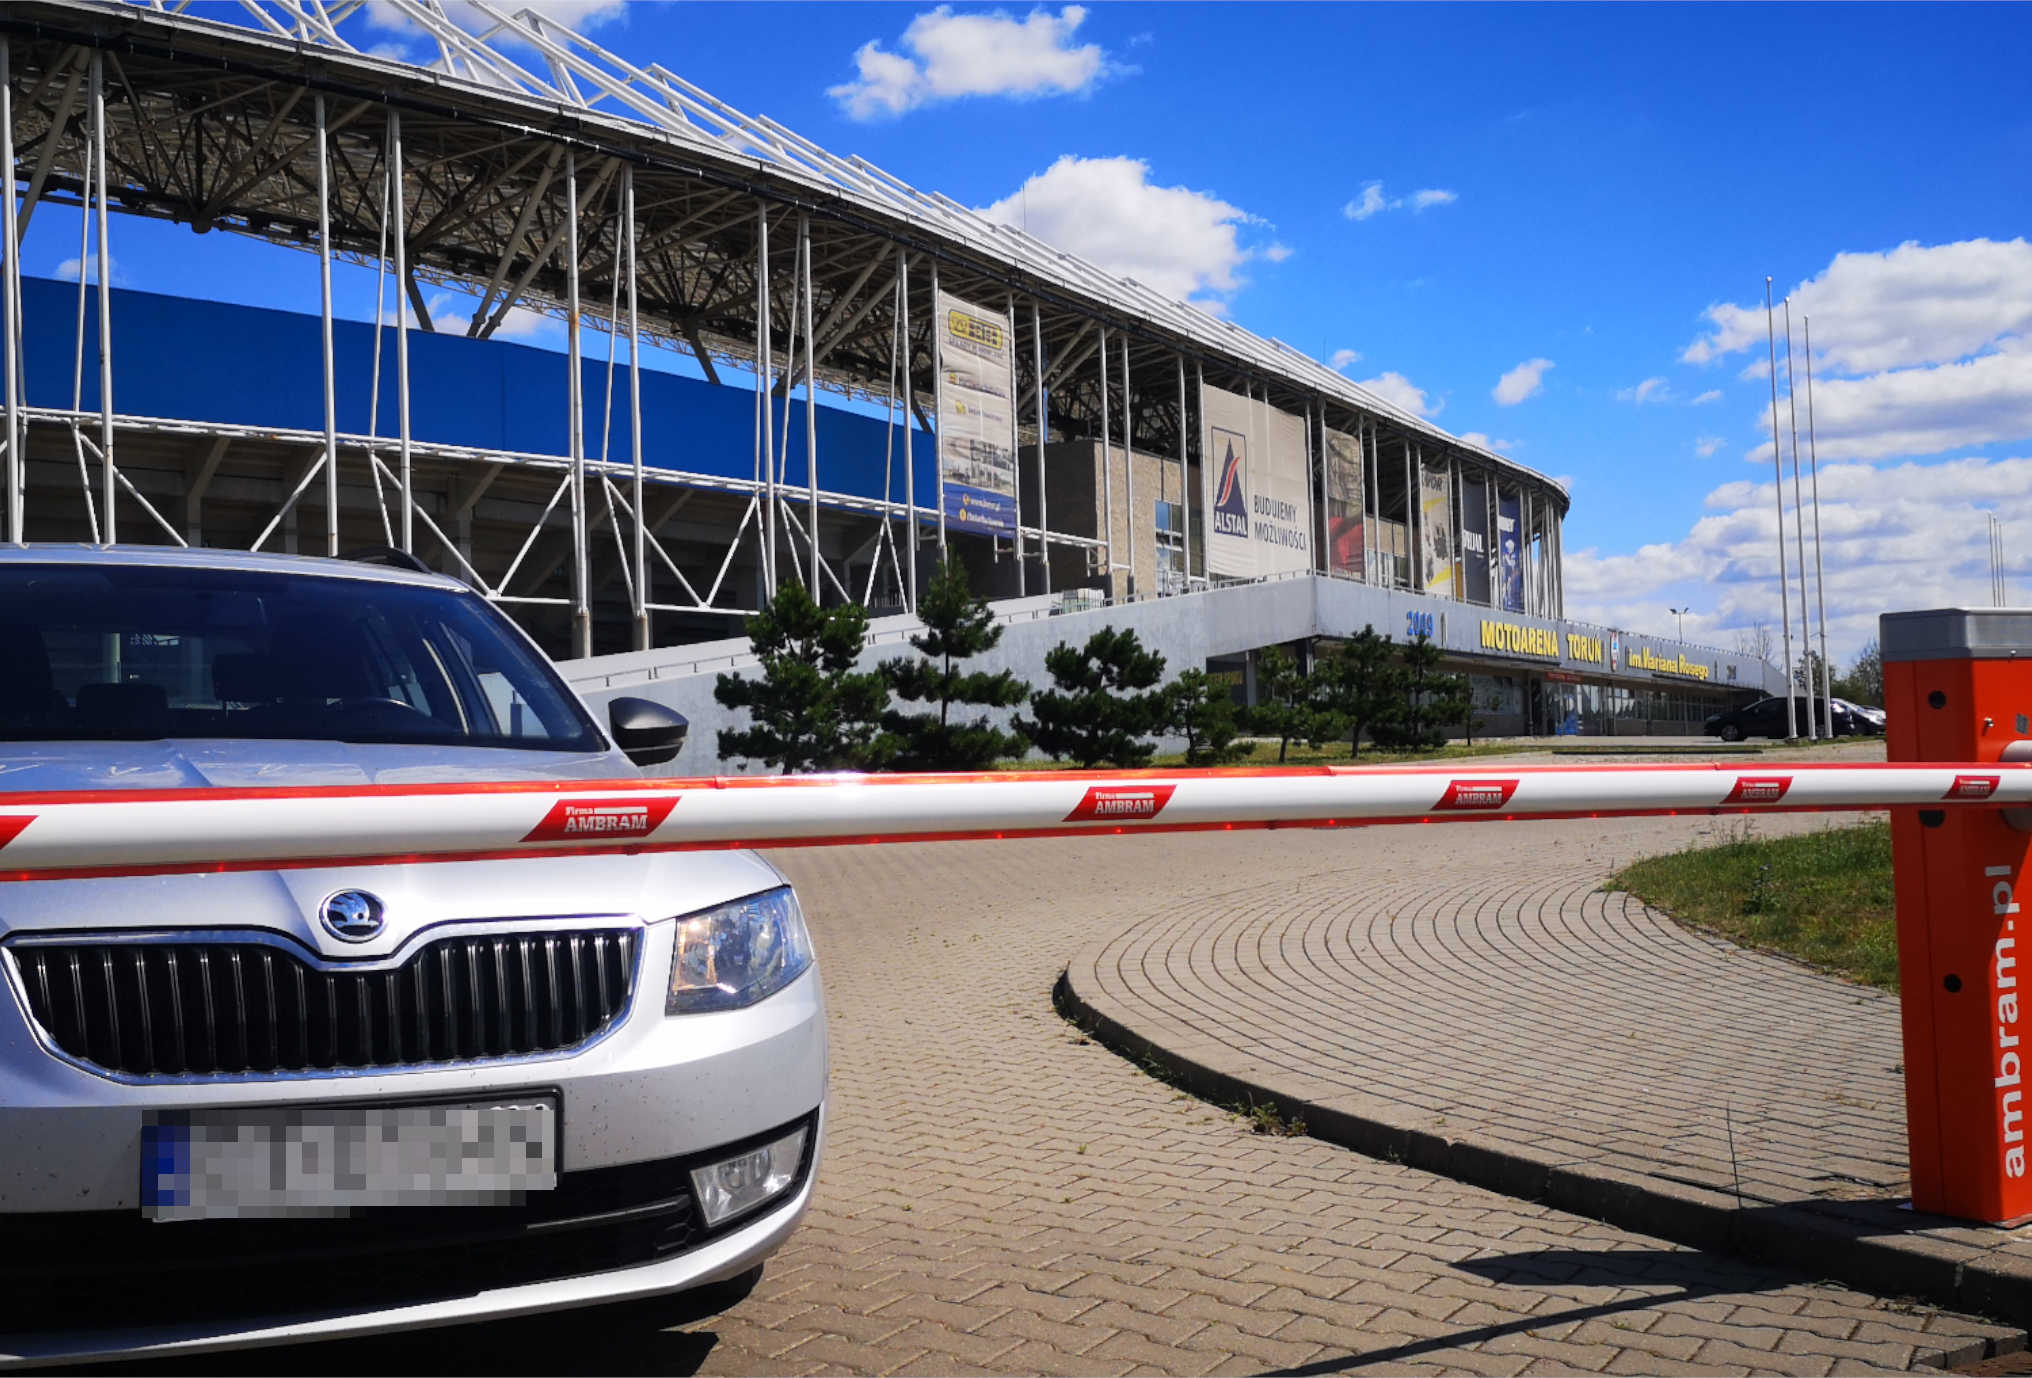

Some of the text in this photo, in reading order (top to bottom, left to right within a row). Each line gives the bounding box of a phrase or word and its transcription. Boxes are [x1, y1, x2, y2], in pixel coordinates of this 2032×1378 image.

[1254, 495, 1297, 522] BUDUJEMY
[1214, 511, 1247, 535] ALSTAL
[1254, 521, 1306, 551] MOŻLIWOŚCI
[1480, 619, 1559, 658] MOTOARENA
[565, 806, 593, 815] Firma
[1095, 800, 1154, 814] AMBRAM
[564, 815, 648, 832] AMBRAM
[1985, 865, 2025, 1179] ambram.pl
